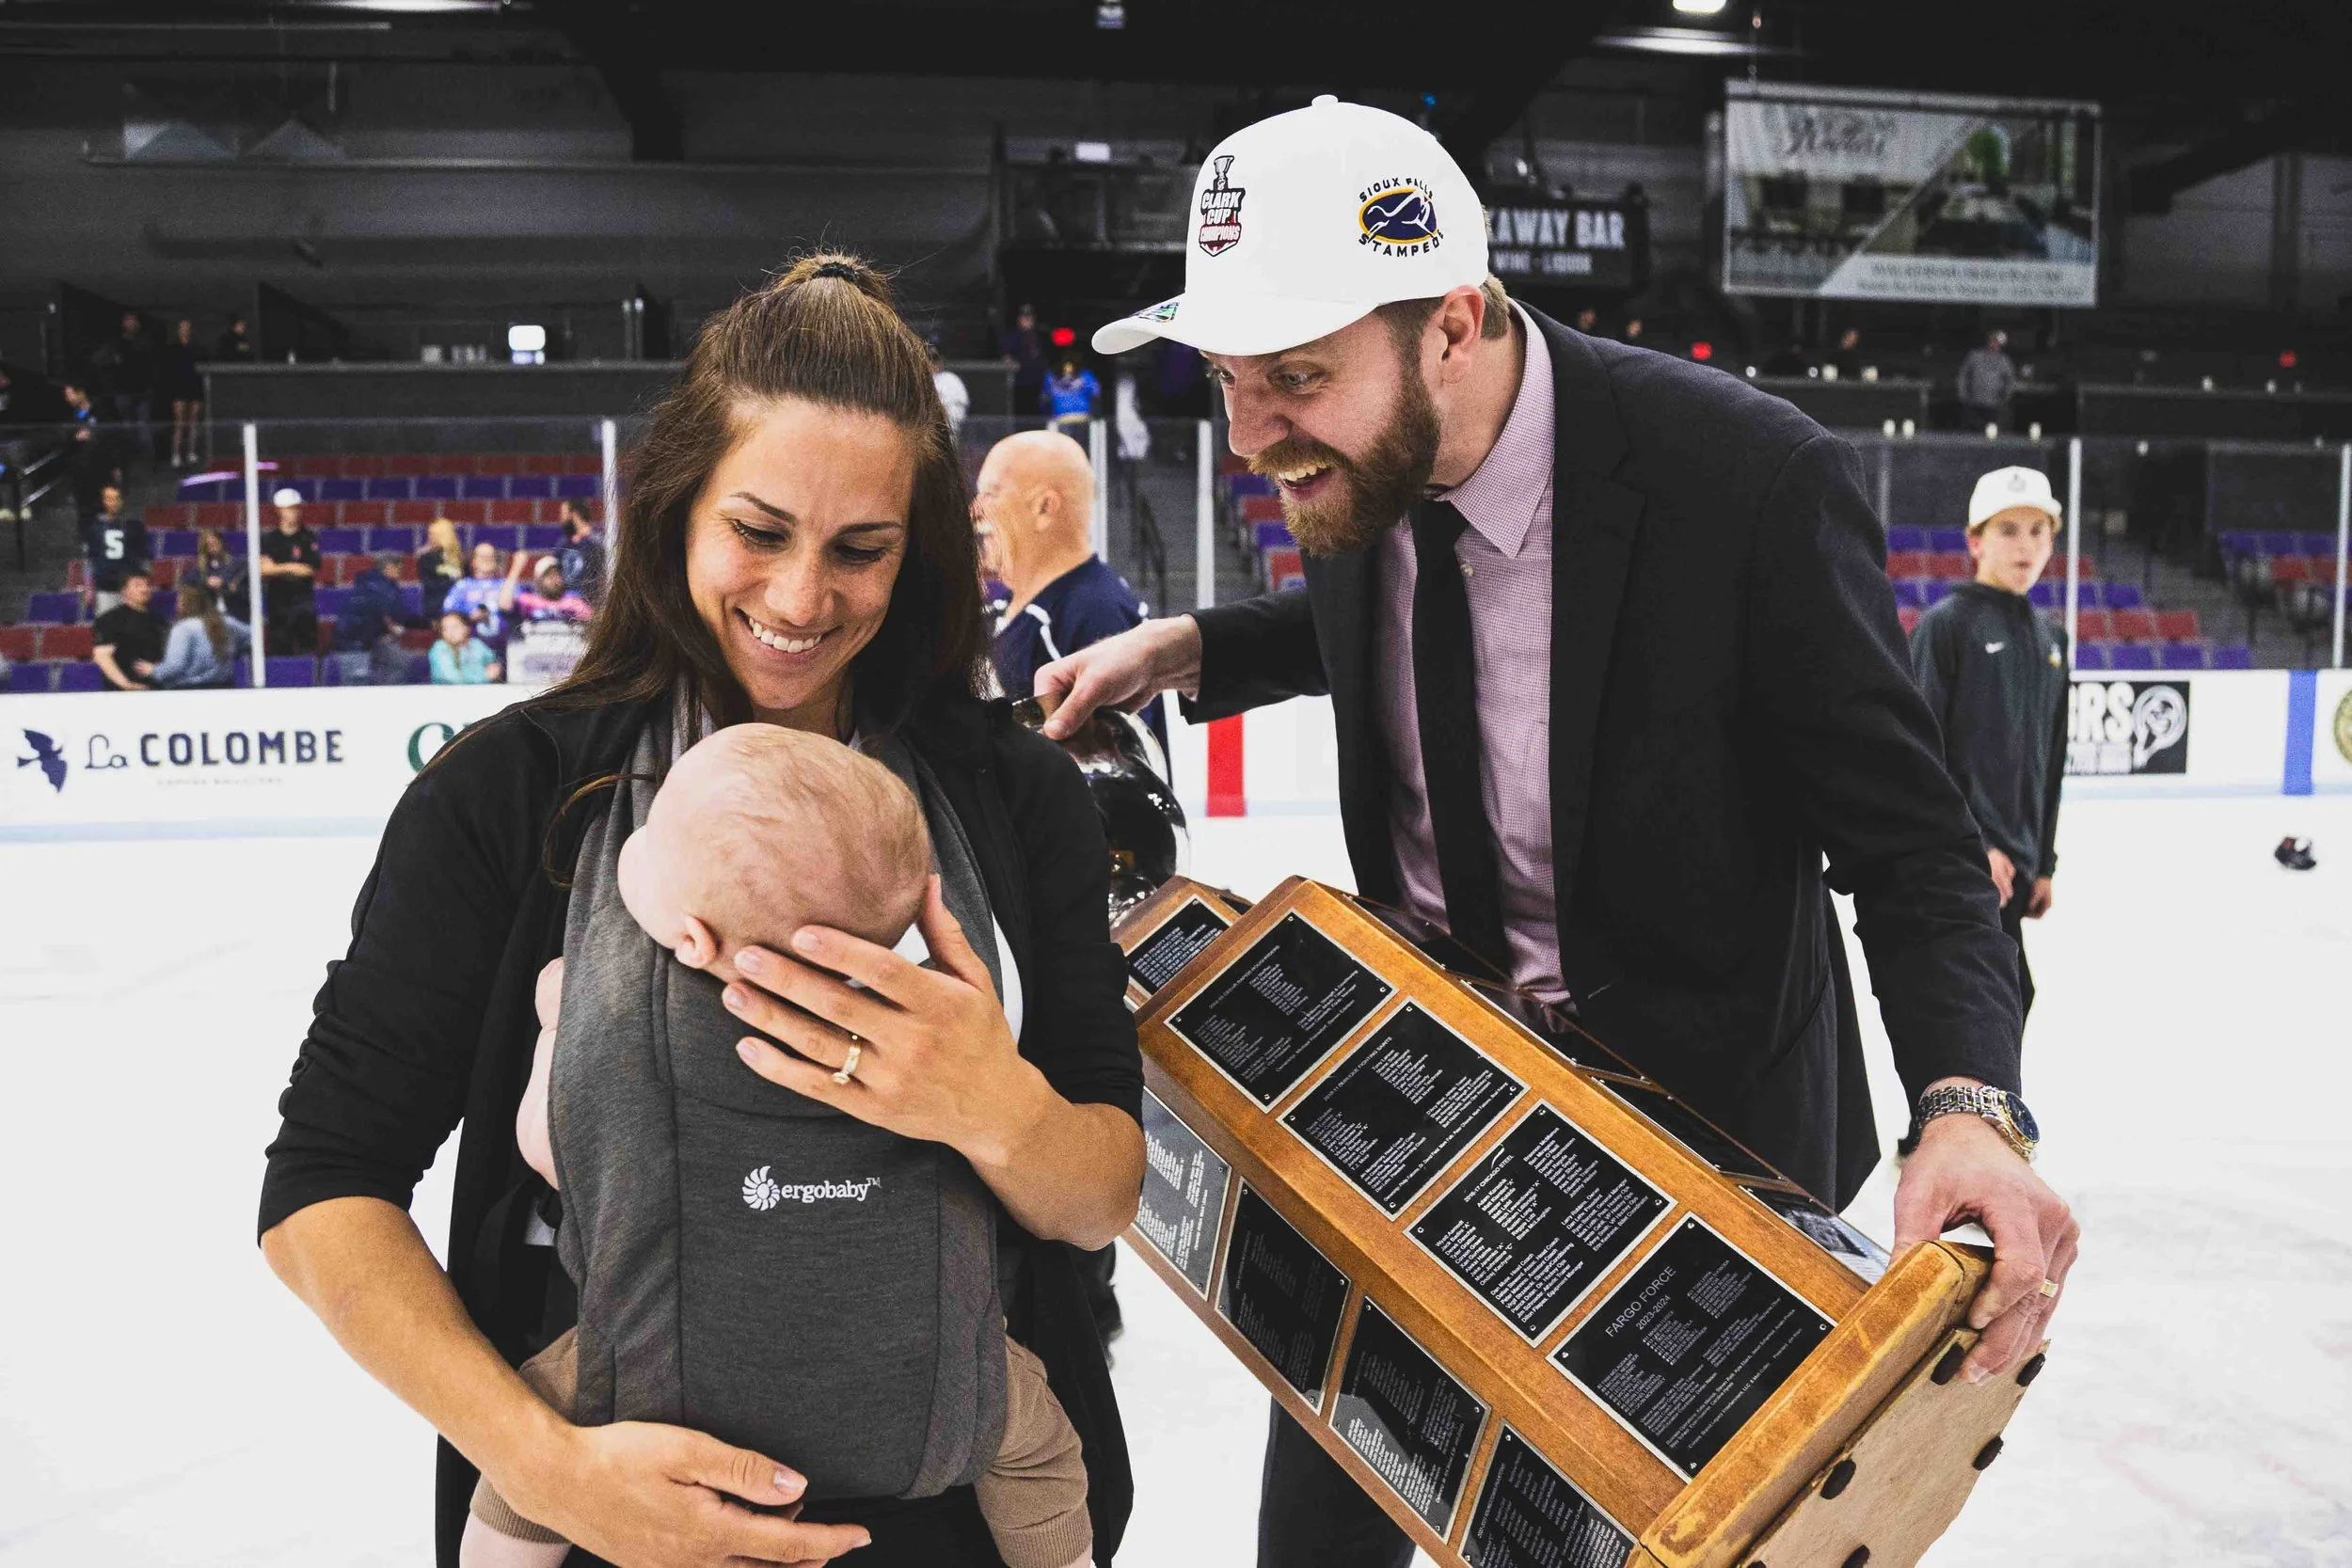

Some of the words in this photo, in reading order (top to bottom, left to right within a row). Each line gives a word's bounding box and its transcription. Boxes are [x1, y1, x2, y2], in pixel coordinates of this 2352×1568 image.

[1359, 178, 1400, 202] SIOUX
[1406, 178, 1433, 199] FALLS
[1202, 191, 1241, 209] CLARK
[1206, 208, 1232, 225] CUP
[1200, 226, 1241, 243] CHAMPIONS
[1576, 209, 1626, 249] BAR
[1359, 229, 1443, 257] STAMPEDE
[85, 734, 129, 768] La
[140, 730, 343, 767] COLOMBE
[1539, 1126, 1561, 1146] McManus
[1528, 1156, 1538, 1165] Ben
[1478, 1166, 1501, 1187] CHICAGO
[1498, 1153, 1514, 1168] STEEL
[1548, 1166, 1565, 1182] Jordan
[781, 1180, 868, 1203] ergobaby
[1476, 1194, 1490, 1207] Adam
[1519, 1206, 1532, 1218] Long
[1469, 1235, 1484, 1250] Green
[1545, 1236, 1559, 1250] Coach
[1450, 1247, 1462, 1259] Tyler
[1543, 1247, 1558, 1261] Coach
[1489, 1285, 1501, 1295] Dan
[1519, 1251, 1534, 1266] Coach
[1565, 1259, 1584, 1278] Manager
[1604, 1299, 1643, 1337] FARGO
[1638, 1265, 1677, 1302] FORCE
[1634, 1293, 1672, 1330] 2023-2024
